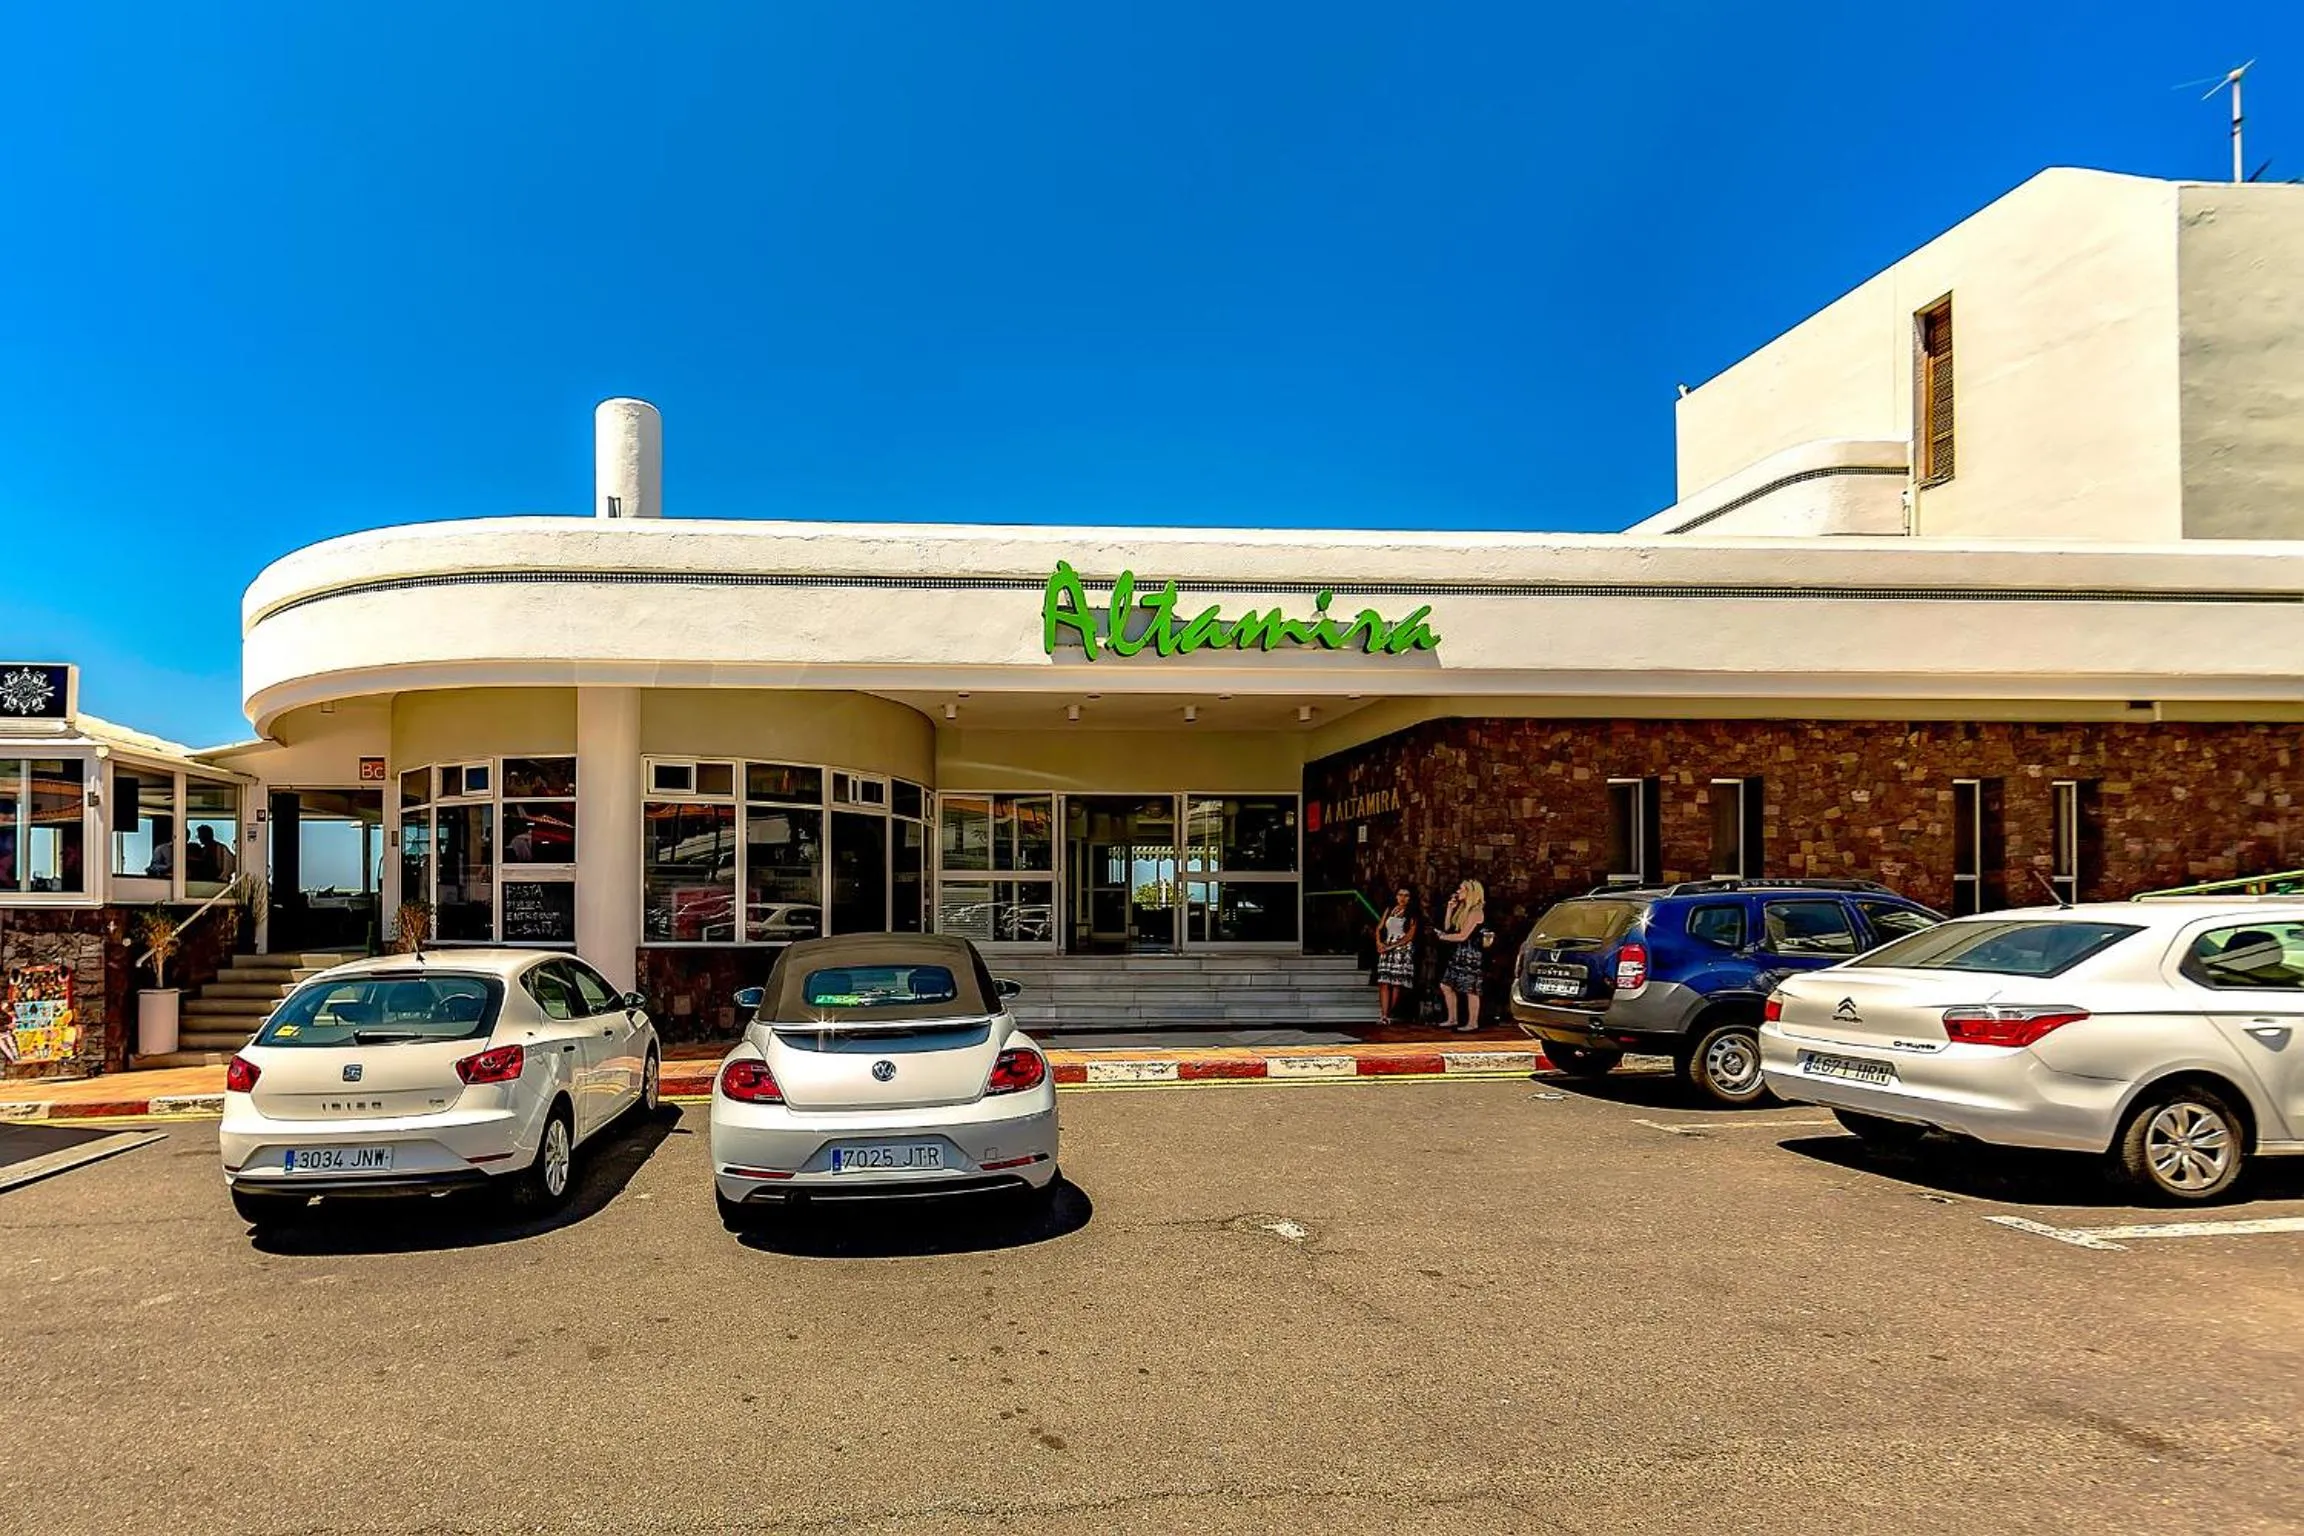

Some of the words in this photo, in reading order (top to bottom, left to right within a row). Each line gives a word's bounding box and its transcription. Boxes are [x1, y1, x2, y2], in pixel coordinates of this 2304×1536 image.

[1042, 560, 1441, 661] Altamira
[1335, 787, 1400, 822] ALTAMIRA
[1812, 1057, 1850, 1076] 4671
[299, 1150, 344, 1168] 3034
[350, 1149, 386, 1167] JNW
[843, 1148, 893, 1169] 7025
[902, 1146, 940, 1166] JTR
